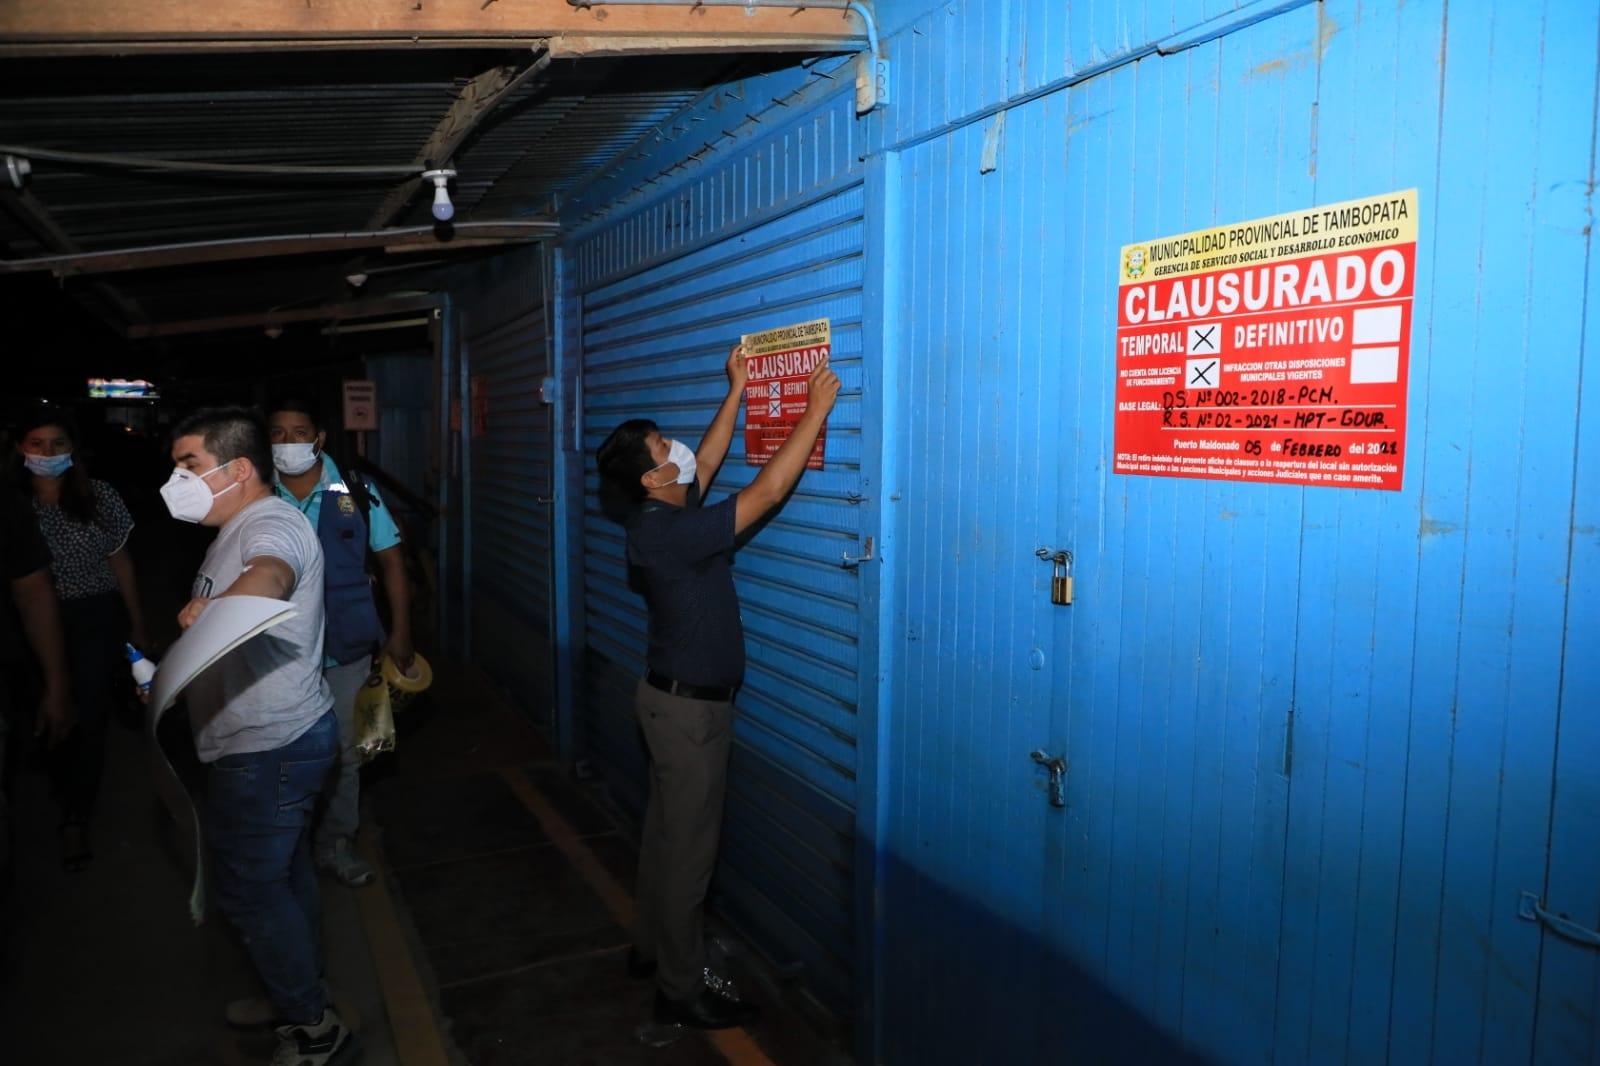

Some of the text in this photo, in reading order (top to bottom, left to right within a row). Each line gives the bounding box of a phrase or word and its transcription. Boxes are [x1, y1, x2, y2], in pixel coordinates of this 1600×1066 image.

[1150, 198, 1408, 262] MUNICIPALIDAD PROVINCIAL DE TAMBOPATA
[1154, 262, 1188, 276] GERENCIA
[1190, 260, 1200, 270] DE
[1202, 254, 1237, 268] SERVICIO
[1239, 248, 1268, 262] SOCIAL
[1271, 247, 1276, 256] Y
[1278, 237, 1335, 256] DESARROLLO
[1125, 249, 1406, 324] CLAUSURADO
[1234, 316, 1344, 349] DEFINITIVO
[1121, 332, 1184, 356] TEMPORAL
[1148, 367, 1158, 376] CON
[1265, 360, 1287, 370] OTRAS
[1288, 357, 1346, 369] DISPOSICIONES
[1240, 369, 1323, 382] MUNICIPALES VIGENTES
[784, 381, 808, 396] DEFINITI
[1119, 400, 1162, 411] BASE LEGAL:
[1174, 439, 1197, 449] Puerto
[1199, 440, 1240, 450] Maldonado
[1244, 439, 1262, 456] 05
[1270, 441, 1281, 451] de
[1349, 443, 1364, 454] del
[1273, 460, 1305, 469] reapertura
[1308, 461, 1318, 469] del
[1320, 462, 1337, 470] local
[1338, 462, 1350, 470] sin
[1208, 466, 1241, 477] Municipales
[1247, 469, 1274, 478] acciones
[1275, 470, 1308, 480] Judiciales
[1309, 472, 1322, 481] que
[1333, 474, 1351, 482] caso
